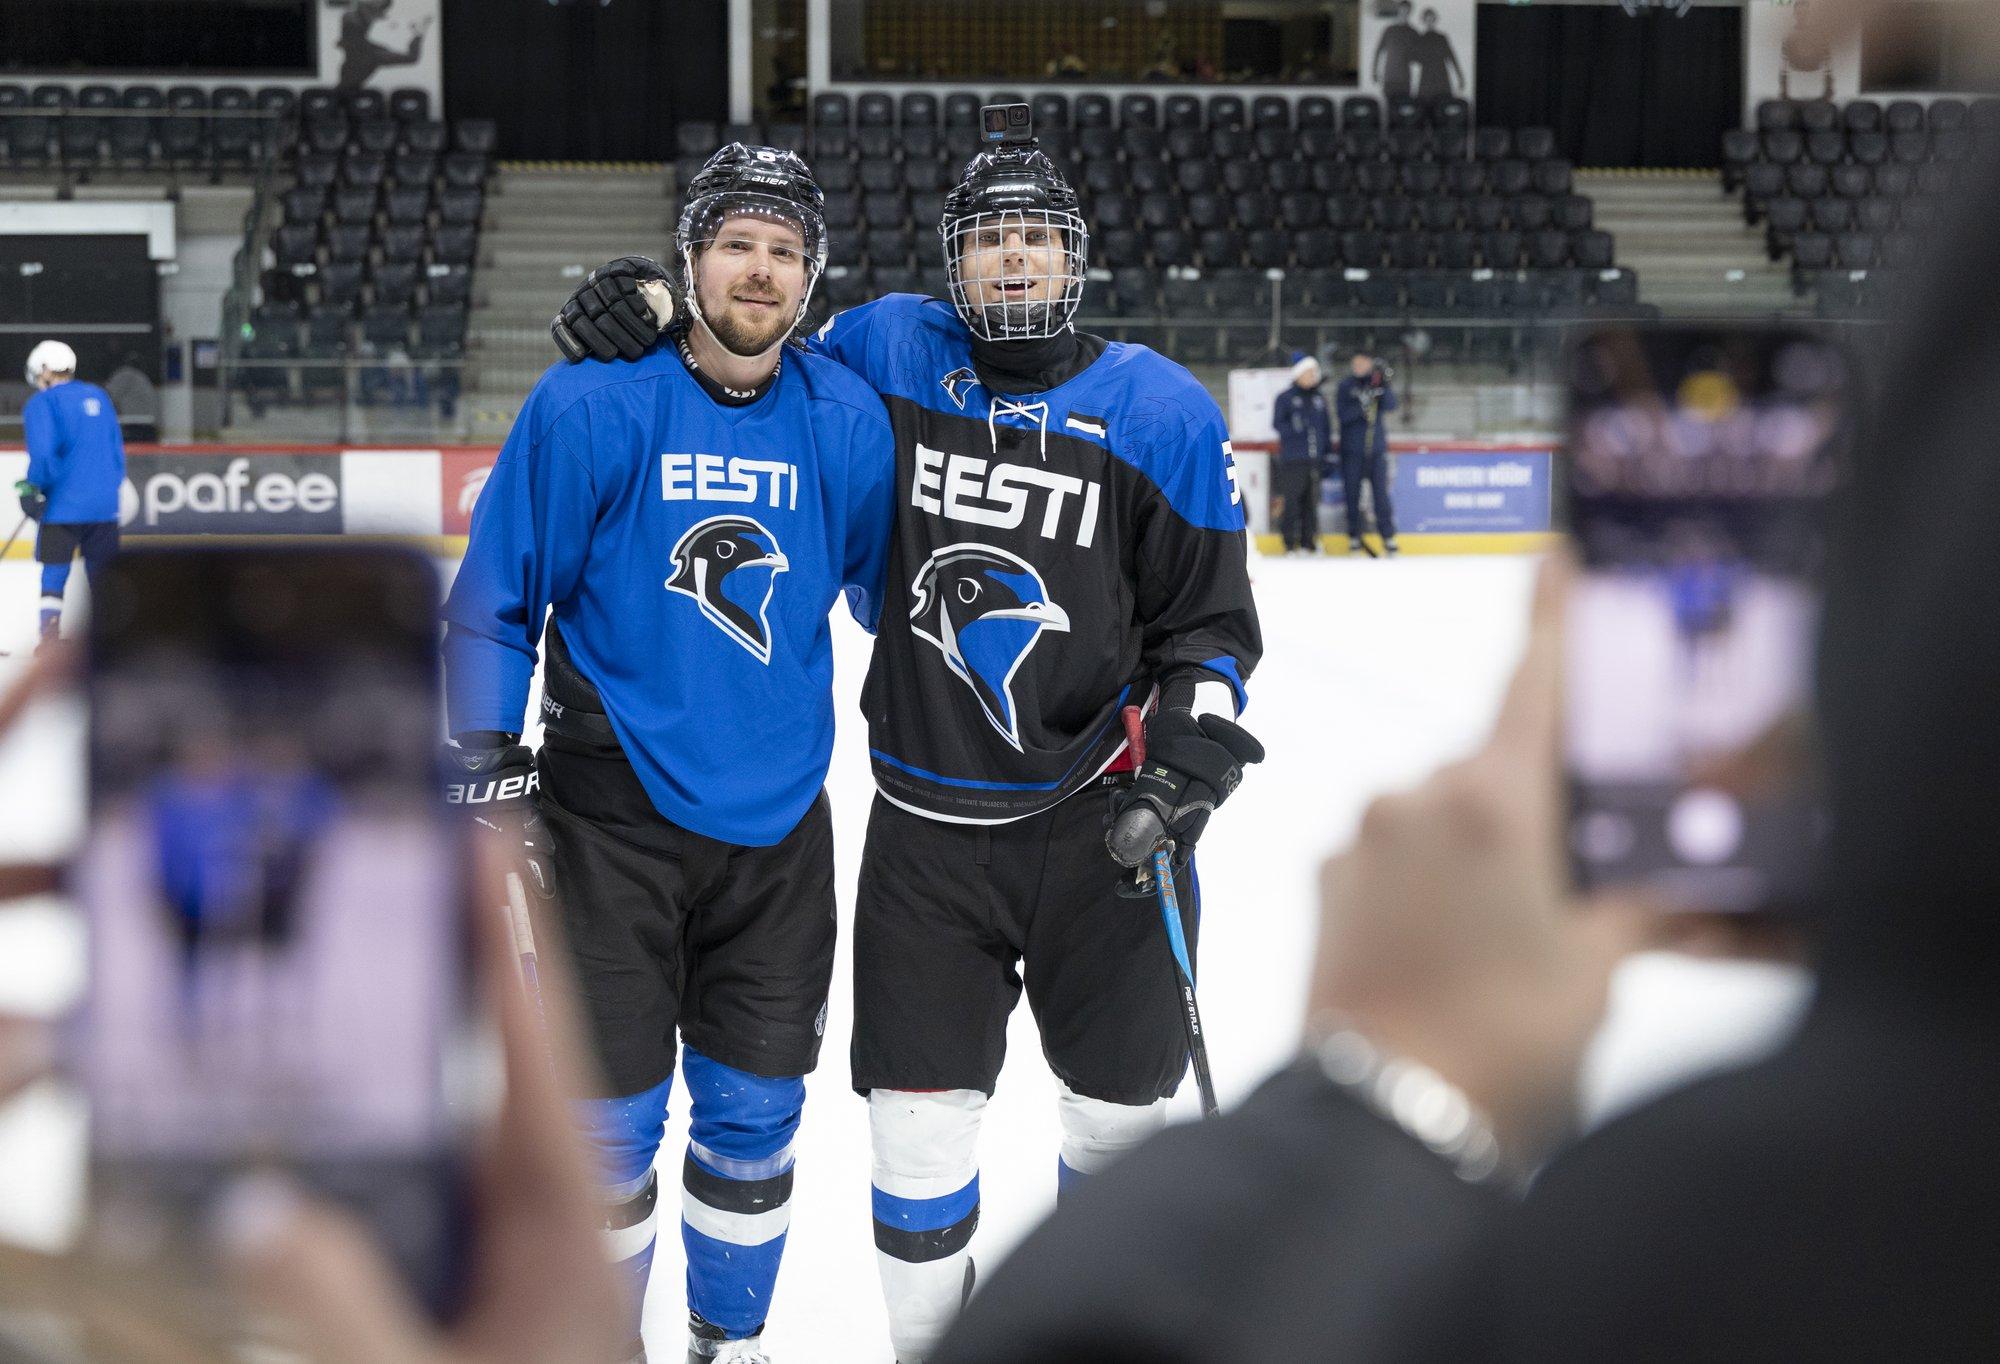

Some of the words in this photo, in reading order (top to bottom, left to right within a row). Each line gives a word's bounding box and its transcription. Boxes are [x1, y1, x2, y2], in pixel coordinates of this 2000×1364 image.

[144, 457, 338, 527] paf.ee
[661, 453, 798, 511] EESTI
[911, 443, 1101, 549] EESTI
[1155, 854, 1178, 910] YNC
